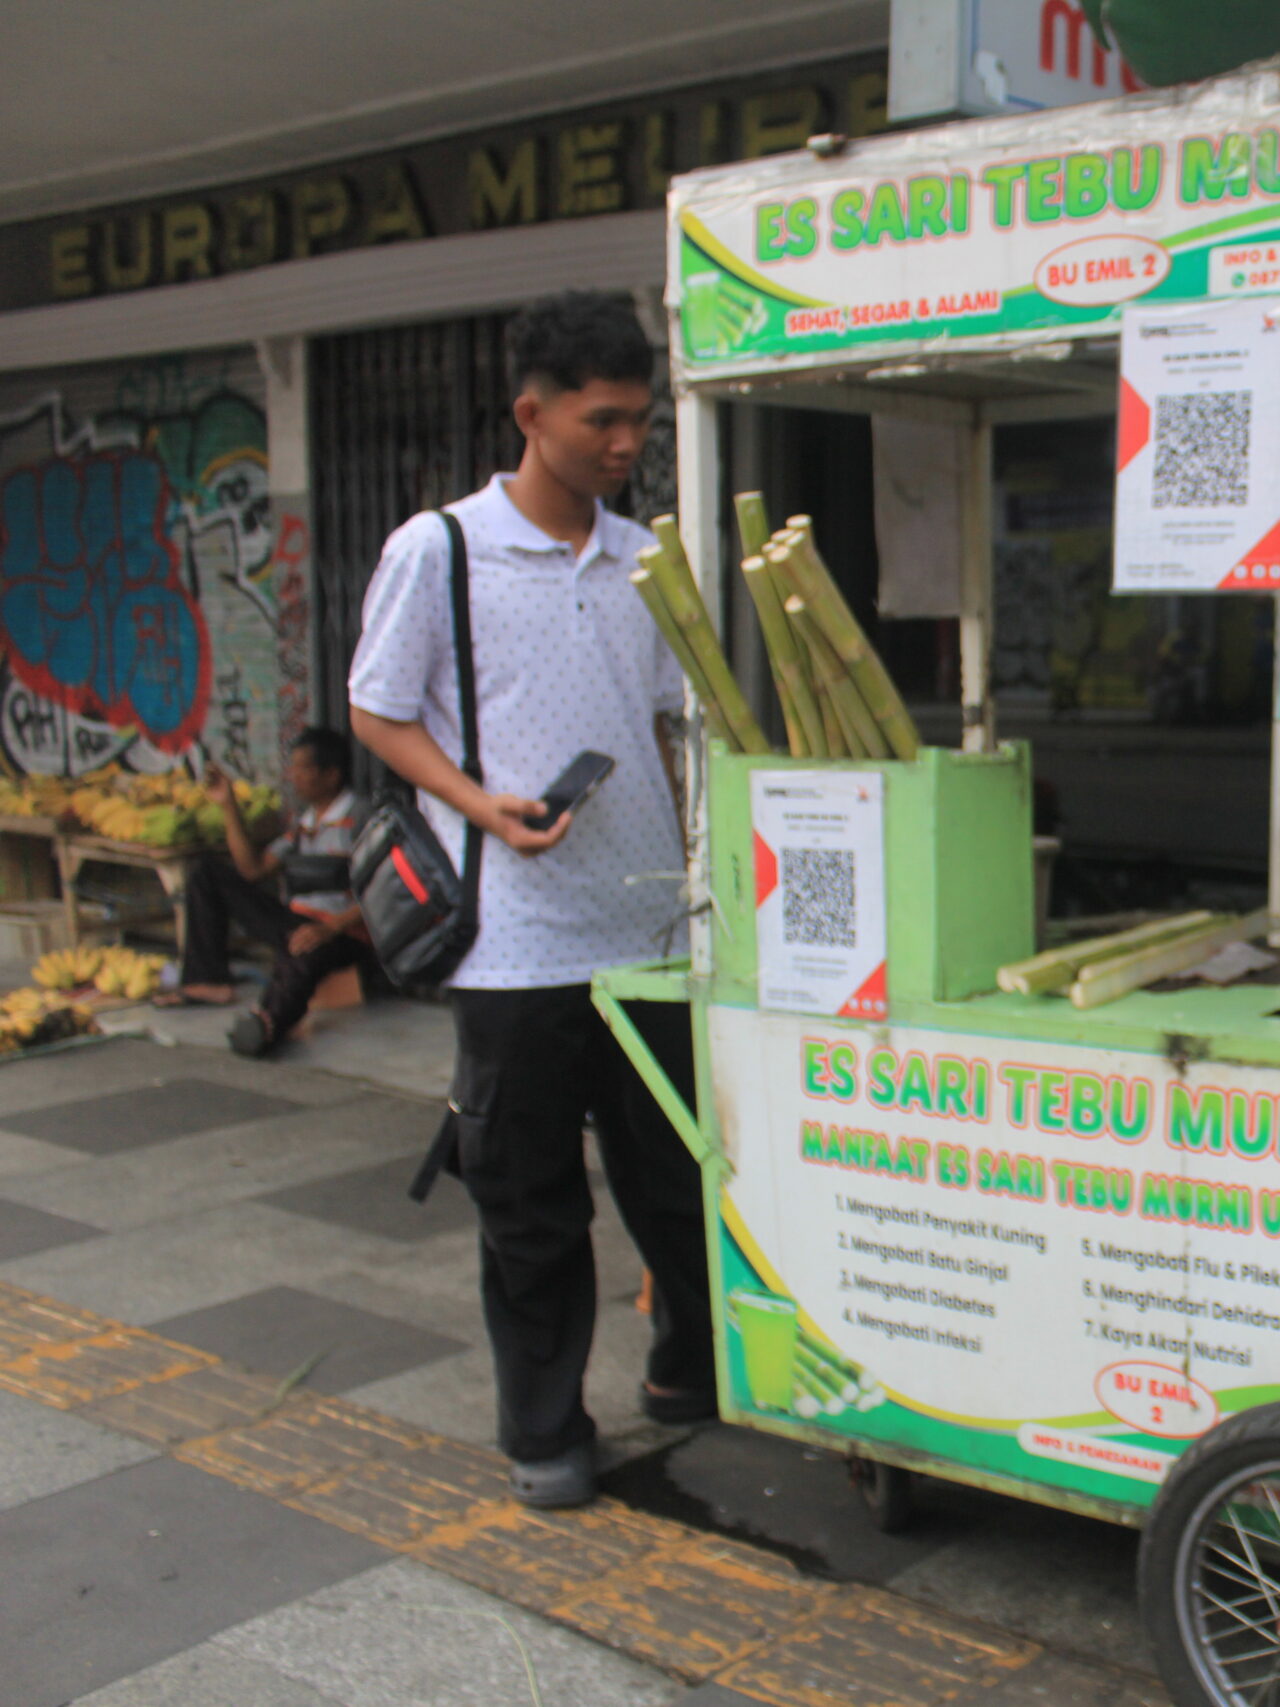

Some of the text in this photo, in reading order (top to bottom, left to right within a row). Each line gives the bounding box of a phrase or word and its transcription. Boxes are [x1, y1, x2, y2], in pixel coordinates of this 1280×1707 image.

[754, 195, 818, 264] ES
[829, 173, 971, 252] SARI
[983, 143, 1162, 229] TEBU
[50, 165, 426, 296] EUROPA
[1047, 254, 1157, 287] BU EMIL 2
[1223, 250, 1262, 266] INFO
[788, 292, 999, 335] SEHAT, SEGAR & ALAMI
[803, 1040, 857, 1101] ES
[868, 1048, 988, 1121] SARI
[1002, 1065, 1151, 1140] TEBU
[802, 1123, 927, 1181] MANFAAT
[937, 1143, 969, 1188] ES
[978, 1150, 1044, 1201] SARI
[1053, 1159, 1131, 1214] TEBU
[1141, 1173, 1250, 1233] MURNI
[846, 1197, 919, 1224] Mengobati
[923, 1212, 988, 1238] Penyakit
[992, 1225, 1047, 1254] Kuning
[851, 1235, 924, 1263] Mengobati
[928, 1250, 962, 1274] Batu
[965, 1258, 1008, 1284] Ginjal
[1099, 1241, 1189, 1271] Mengobati
[1194, 1255, 1219, 1279] Flu
[1224, 1261, 1236, 1281] &
[854, 1272, 927, 1301] Mengobati
[931, 1289, 996, 1317] Diabetes
[1100, 1282, 1209, 1318] Menghindari
[856, 1311, 930, 1340] Mengobati
[935, 1327, 983, 1353] Infeksi
[1101, 1322, 1143, 1349] Kaya
[1147, 1332, 1189, 1355] Akan
[1194, 1340, 1252, 1367] Nutrisi
[1114, 1371, 1193, 1404] BU EMIL
[1151, 1405, 1164, 1424] 2
